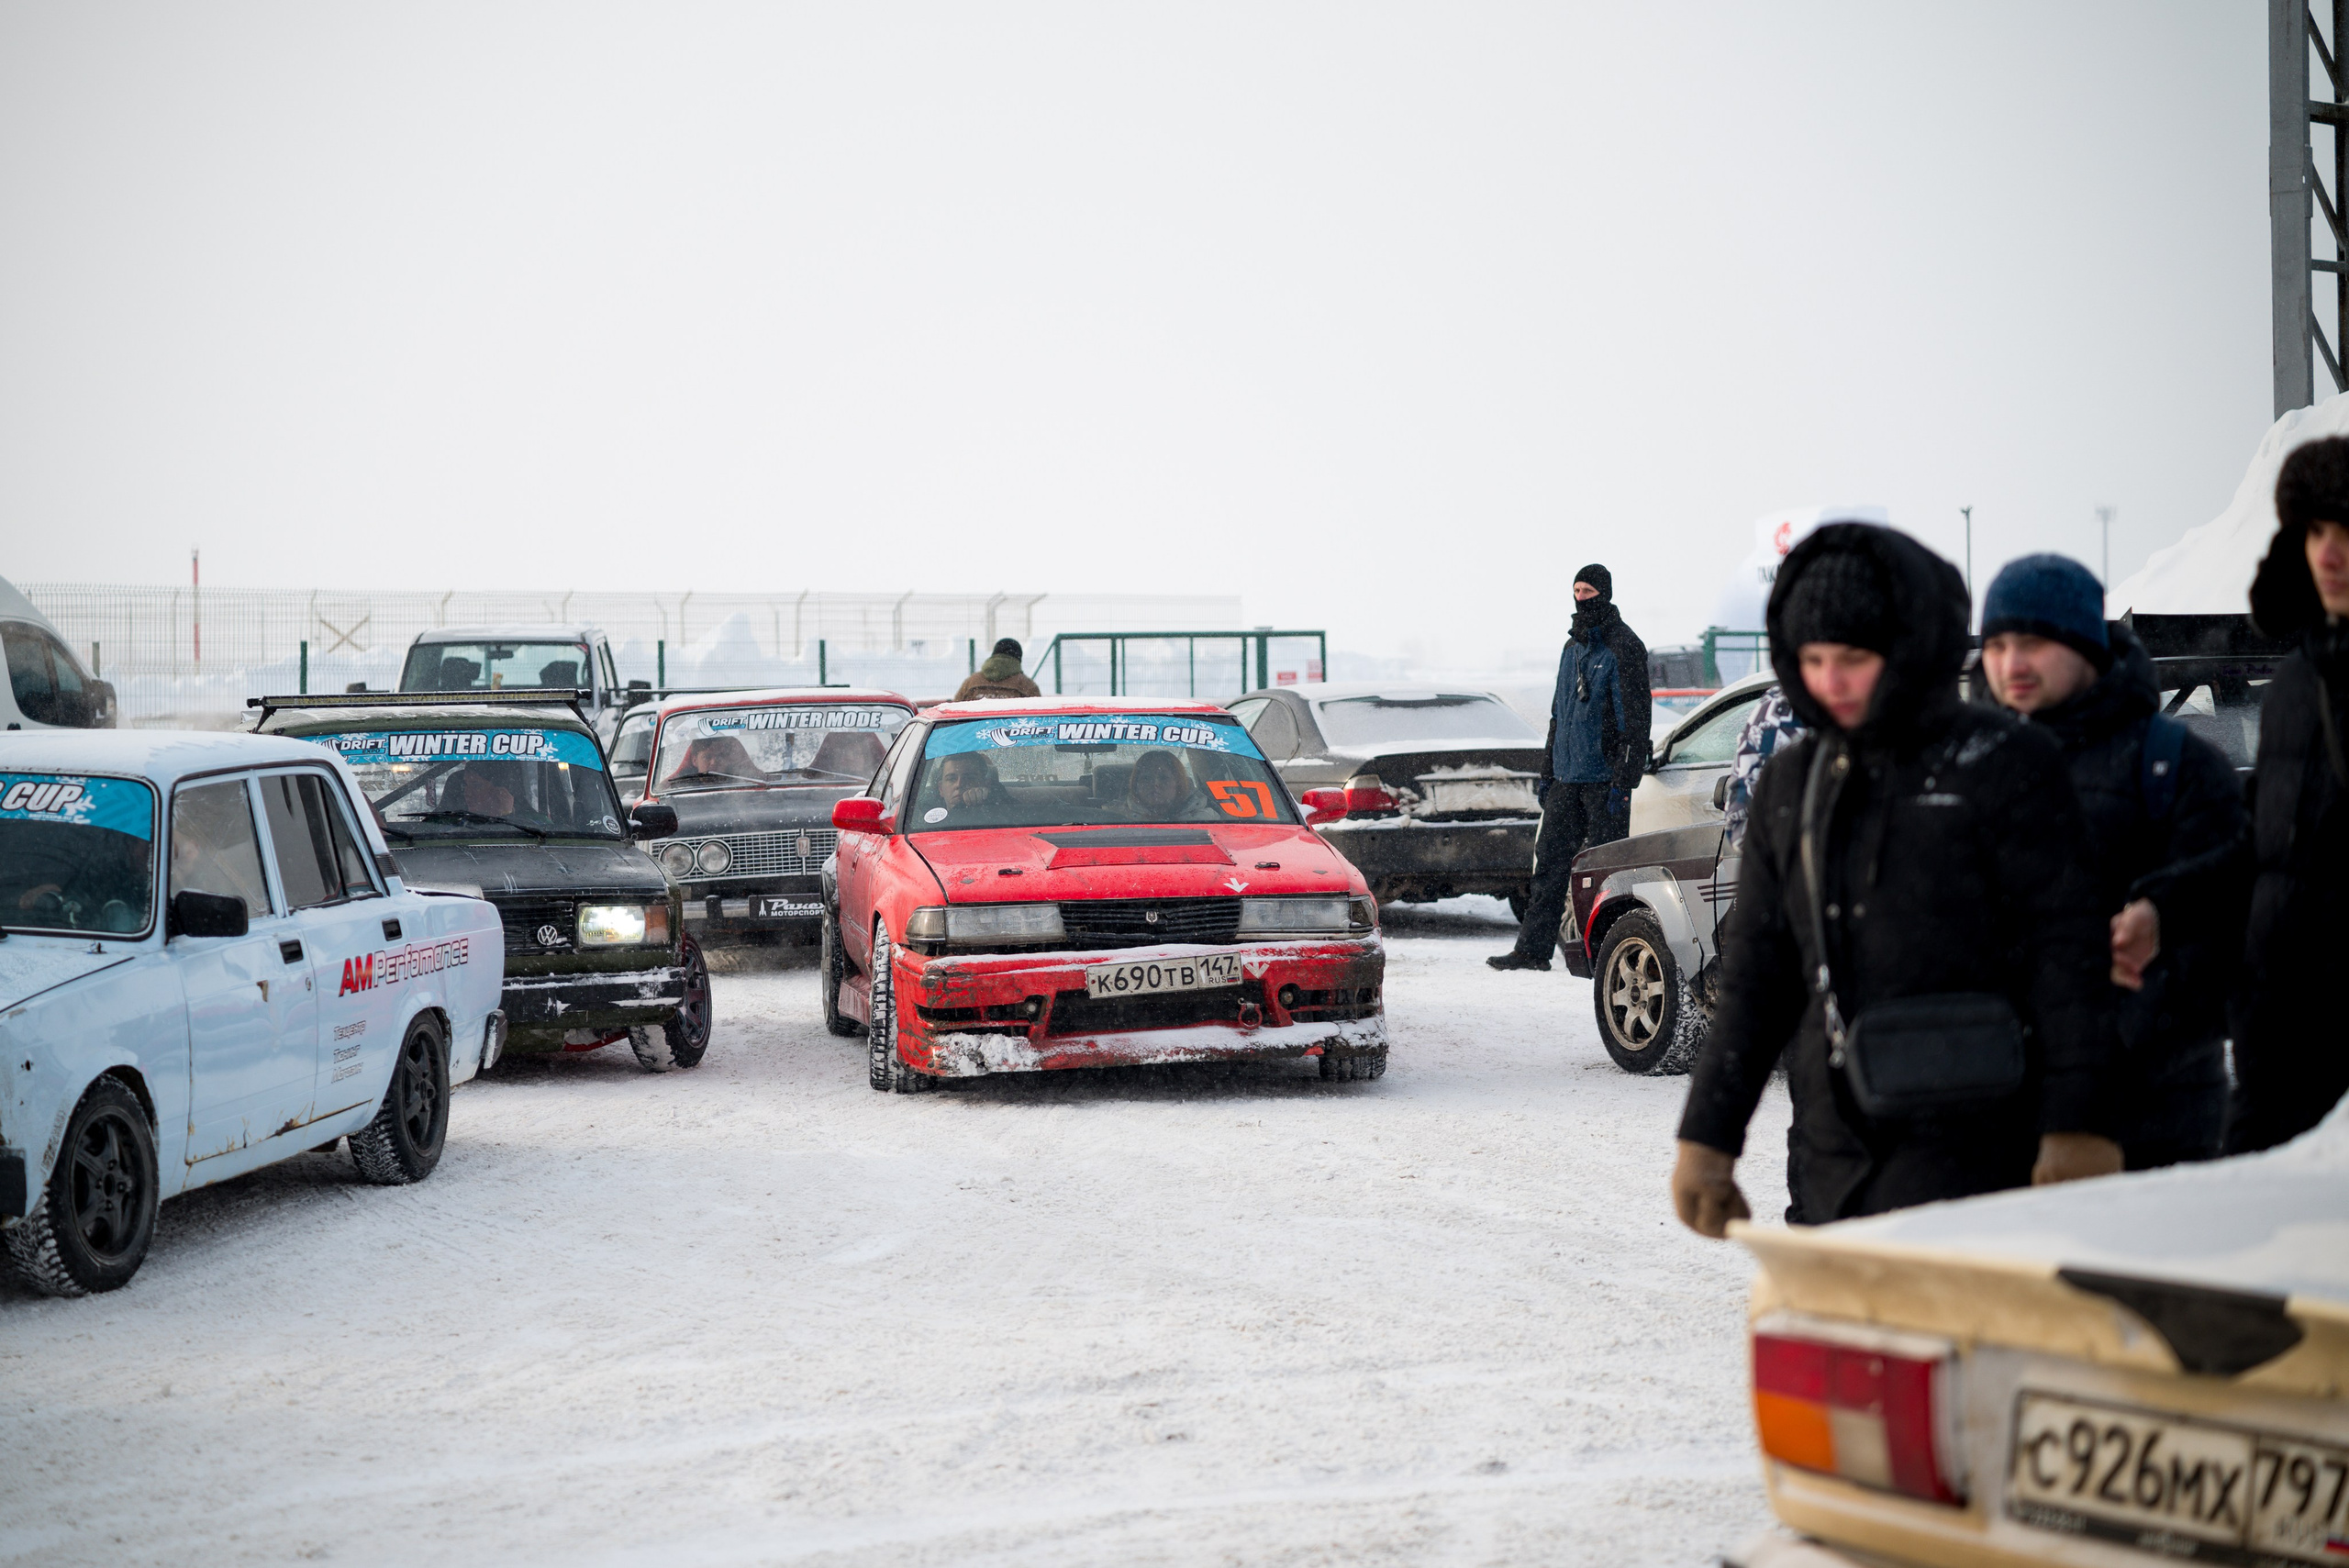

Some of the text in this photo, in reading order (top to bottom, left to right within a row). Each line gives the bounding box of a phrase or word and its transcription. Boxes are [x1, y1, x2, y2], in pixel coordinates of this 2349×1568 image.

[712, 711, 882, 730] DRIFT WINTER MODE
[340, 732, 545, 756] DRIFT WINTER CUP
[1009, 723, 1216, 745] DRIFT WINTER CUP
[1, 781, 84, 813] CUP
[1206, 780, 1278, 819] 57
[1200, 956, 1234, 976] 147
[2256, 1449, 2349, 1522] 797
